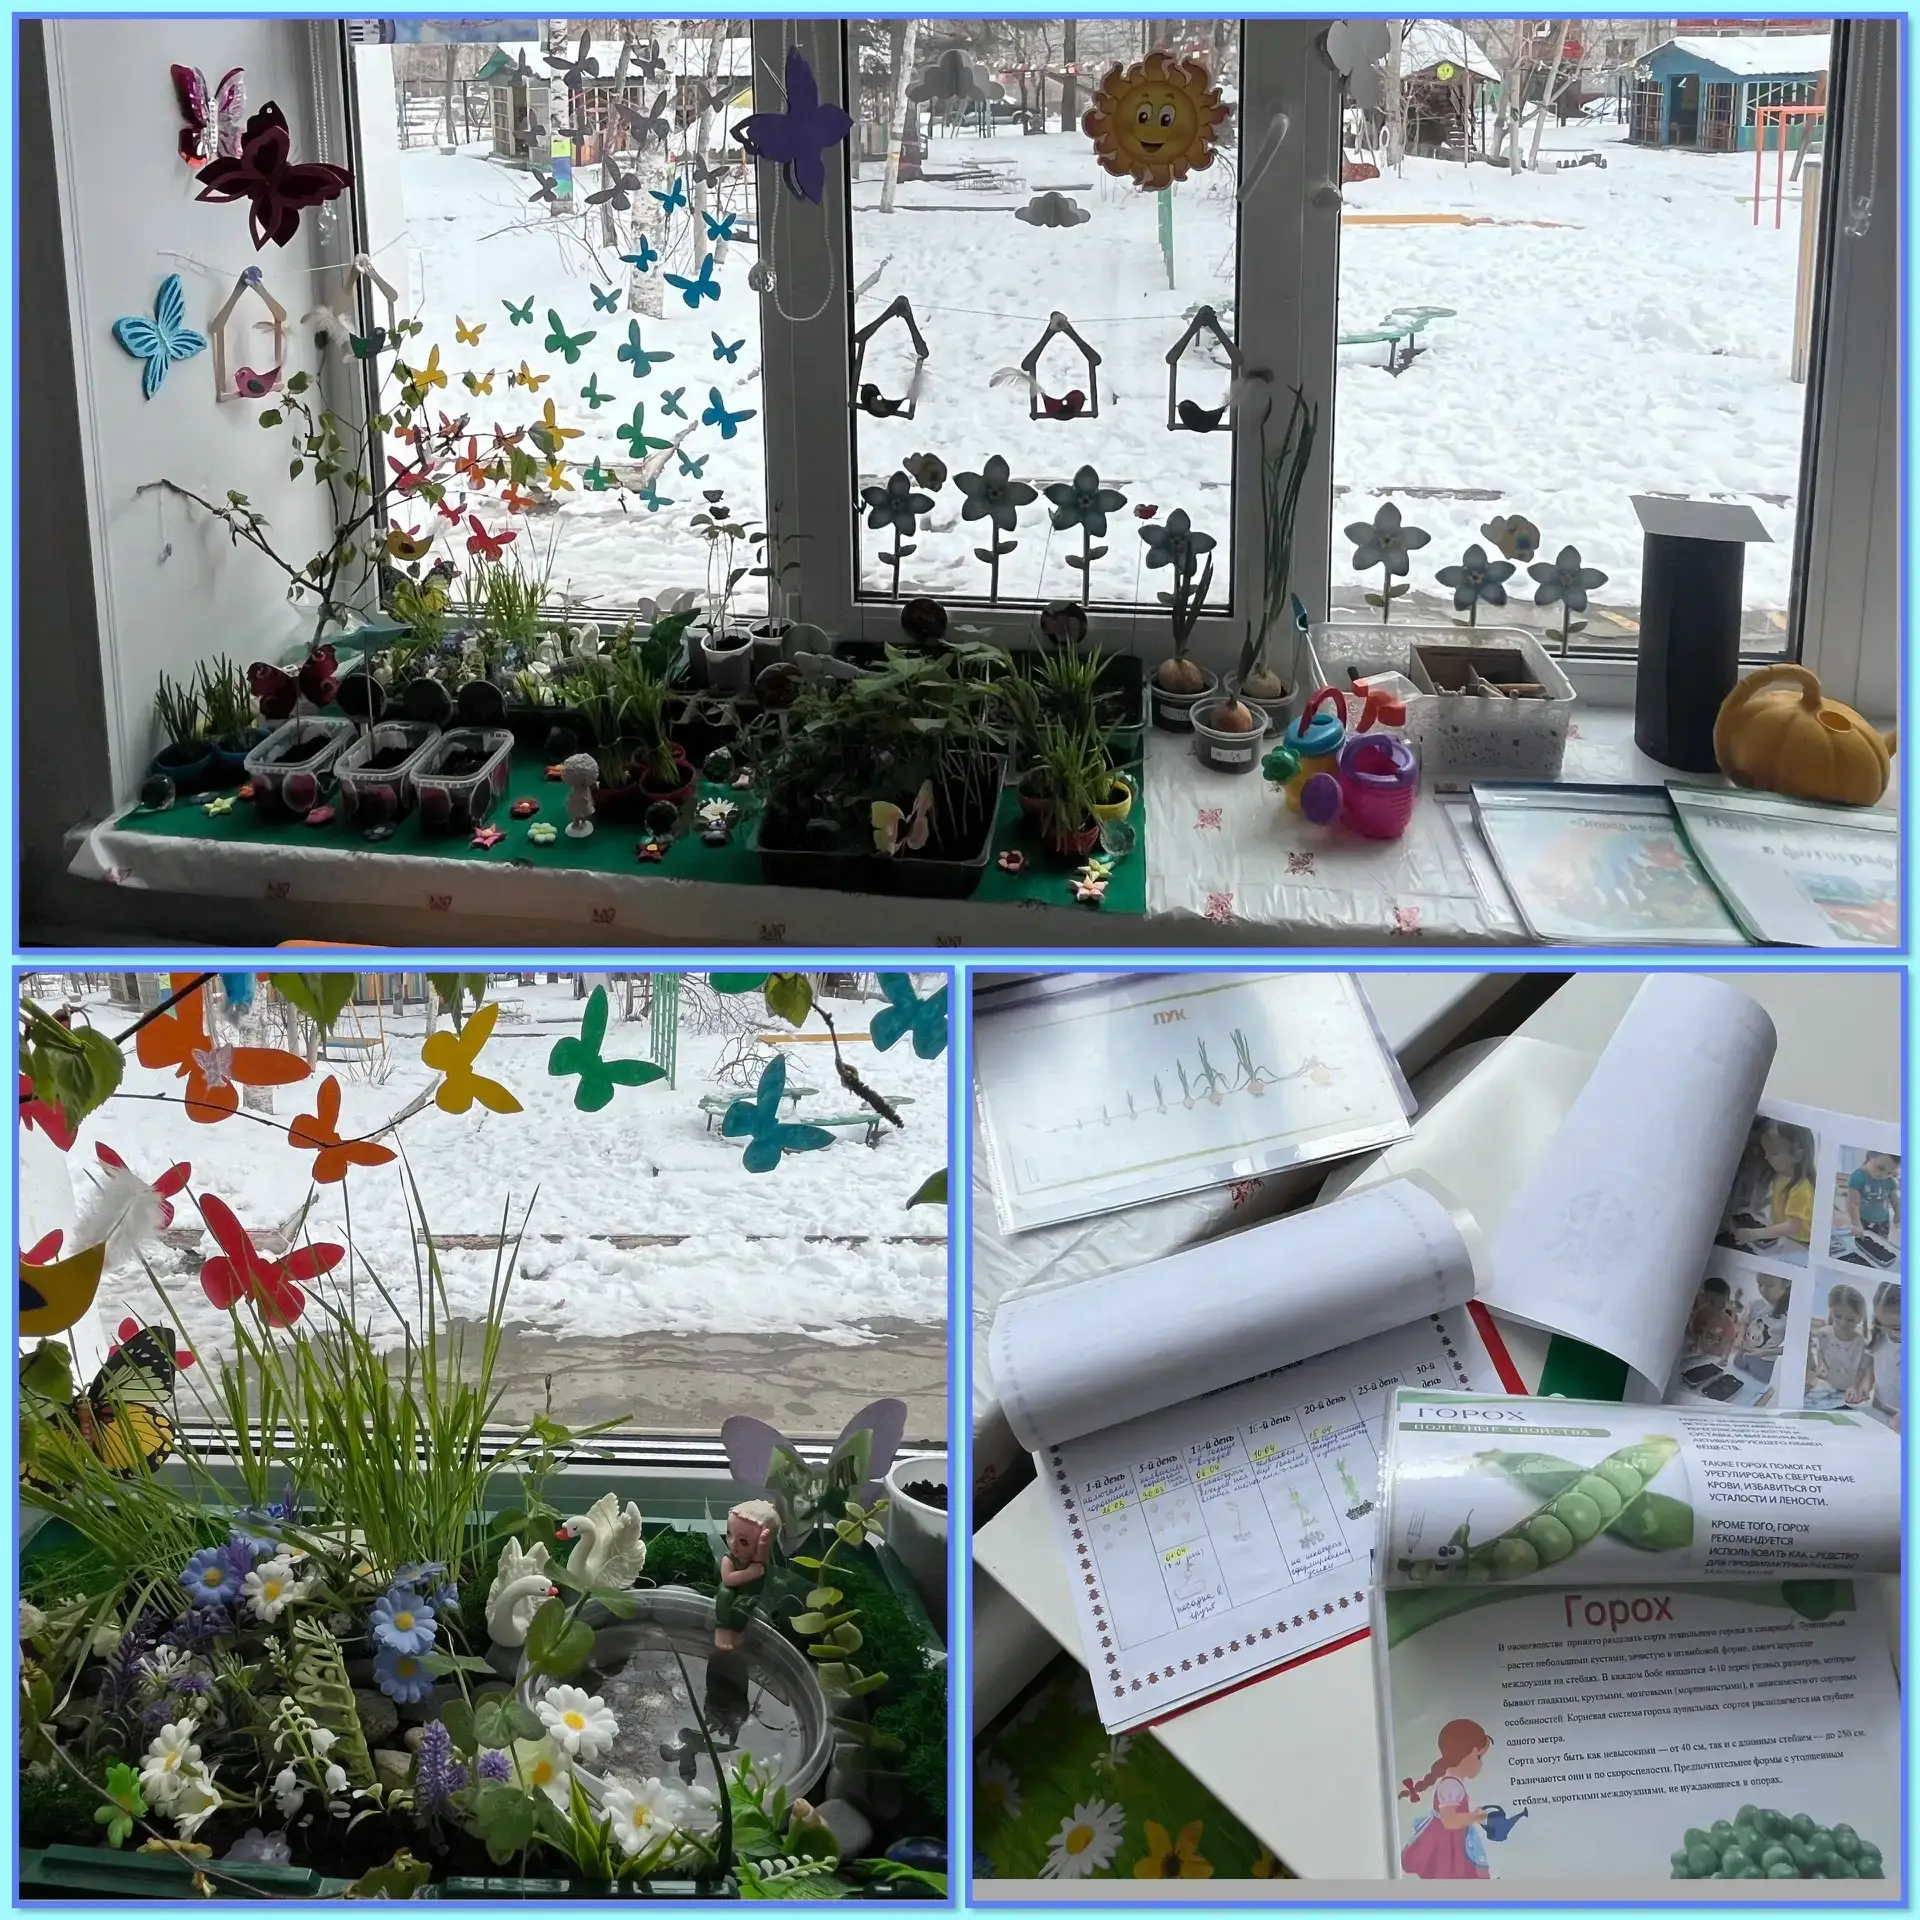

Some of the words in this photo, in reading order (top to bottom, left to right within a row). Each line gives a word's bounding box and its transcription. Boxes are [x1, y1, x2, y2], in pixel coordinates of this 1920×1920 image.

[1416, 1362, 1436, 1374] 30-й
[1358, 1382, 1378, 1396] 25-й
[1379, 1376, 1398, 1388] день
[1422, 1377, 1442, 1388] день
[1304, 1401, 1324, 1415] 20-й
[1326, 1396, 1346, 1407] день
[1417, 1408, 1527, 1421] ГОРОХ
[1249, 1422, 1269, 1435] 16-й
[1270, 1415, 1290, 1428] день
[1414, 1424, 1500, 1432] ПОЛЕЗНЫЕ
[1508, 1427, 1591, 1436] СВОЙСТВА
[1213, 1435, 1234, 1447] день
[1139, 1464, 1154, 1474] 5-й
[1156, 1456, 1178, 1468] день
[1702, 1460, 1734, 1468] ТАКЖЕ
[1769, 1463, 1823, 1471] ПОМОГАЕТ
[1086, 1480, 1102, 1492] 1-й
[1104, 1474, 1126, 1486] день
[1704, 1470, 1784, 1480] УРЕГУЛИРОВАТЬ
[1784, 1474, 1856, 1483] СВЕРТЫВАНИЕ
[1707, 1482, 1742, 1490] КРОВИ,
[1744, 1483, 1807, 1492] ИЗБАВИТЬСЯ
[1808, 1485, 1822, 1493] ОТ
[1710, 1494, 1767, 1503] УСТАЛОСТИ
[1769, 1496, 1776, 1504] И
[1779, 1496, 1828, 1506] ЛЕНОСТИ.
[1711, 1520, 1746, 1530] КРОМЕ
[1747, 1521, 1776, 1532] ТОГО,
[1778, 1523, 1810, 1532] ГОРОХ
[1711, 1534, 1794, 1545] РЕКОМЕНДУЕТСЯ
[1708, 1547, 1787, 1558] ИСПОЛЬЗОВАТЬ
[1788, 1550, 1807, 1558] КАК
[1564, 1594, 1674, 1634] Горох
[1498, 1643, 1505, 1652] В
[1567, 1638, 1601, 1648] принято
[1602, 1636, 1642, 1646] разделять
[1644, 1634, 1666, 1643] сорта
[1718, 1627, 1746, 1637] гороха
[1508, 1660, 1534, 1671] растет
[1536, 1656, 1588, 1668] небольшими
[1590, 1655, 1626, 1665] кустами,
[1628, 1652, 1666, 1661] зачастую
[1674, 1646, 1718, 1658] штамбовой
[1752, 1642, 1776, 1651] имеет
[1777, 1640, 1814, 1650] короткие
[1502, 1678, 1551, 1689] междоузлия
[1554, 1678, 1564, 1686] на
[1566, 1674, 1599, 1684] стеблях.
[1602, 1673, 1608, 1681] В
[1610, 1672, 1642, 1681] каждом
[1644, 1668, 1663, 1678] бобе
[1666, 1666, 1706, 1677] находится
[1708, 1664, 1726, 1673] 4-10
[1752, 1661, 1781, 1672] разных
[1824, 1655, 1856, 1666] которые
[1503, 1697, 1535, 1708] бывают
[1537, 1694, 1580, 1706] гладкими,
[1581, 1692, 1624, 1704] круглыми,
[1626, 1688, 1672, 1699] мозговыми
[1757, 1678, 1808, 1688] зависимости
[1820, 1672, 1858, 1684] сортовых
[1567, 1712, 1606, 1724] Корневая
[1608, 1710, 1642, 1720] система
[1644, 1706, 1671, 1718] гороха
[1722, 1700, 1750, 1712] сортов
[1752, 1696, 1810, 1709] располагается
[1822, 1692, 1855, 1704] глубине
[1506, 1738, 1536, 1747] одного
[1538, 1734, 1566, 1744] метра.
[1508, 1756, 1534, 1767] Сорта
[1536, 1755, 1562, 1766] могут
[1563, 1752, 1584, 1762] быть
[1586, 1752, 1602, 1760] как
[1604, 1747, 1656, 1759] невысокими
[1670, 1745, 1680, 1753] от
[1682, 1744, 1692, 1752] 40
[1693, 1744, 1707, 1752] см,
[1708, 1742, 1722, 1750] так
[1738, 1737, 1777, 1748] длинным
[1778, 1734, 1812, 1744] стеблем
[1825, 1732, 1836, 1740] до
[1837, 1729, 1852, 1738] 250
[1854, 1730, 1867, 1738] см.
[1510, 1774, 1566, 1786] Различаются
[1568, 1772, 1584, 1781] они
[1586, 1772, 1592, 1780] и
[1594, 1771, 1605, 1779] по
[1607, 1766, 1672, 1779] скороспелости.
[1674, 1759, 1752, 1774] Предпочтительнее
[1754, 1756, 1782, 1768] формы
[1791, 1750, 1844, 1764] утолщенным
[1512, 1796, 1550, 1806] стеблем,
[1552, 1792, 1600, 1804] короткими
[1600, 1787, 1666, 1800] междоузлиями,
[1668, 1786, 1678, 1794] не
[1680, 1780, 1740, 1794] нуждающиеся
[1750, 1775, 1782, 1787] опорах.
